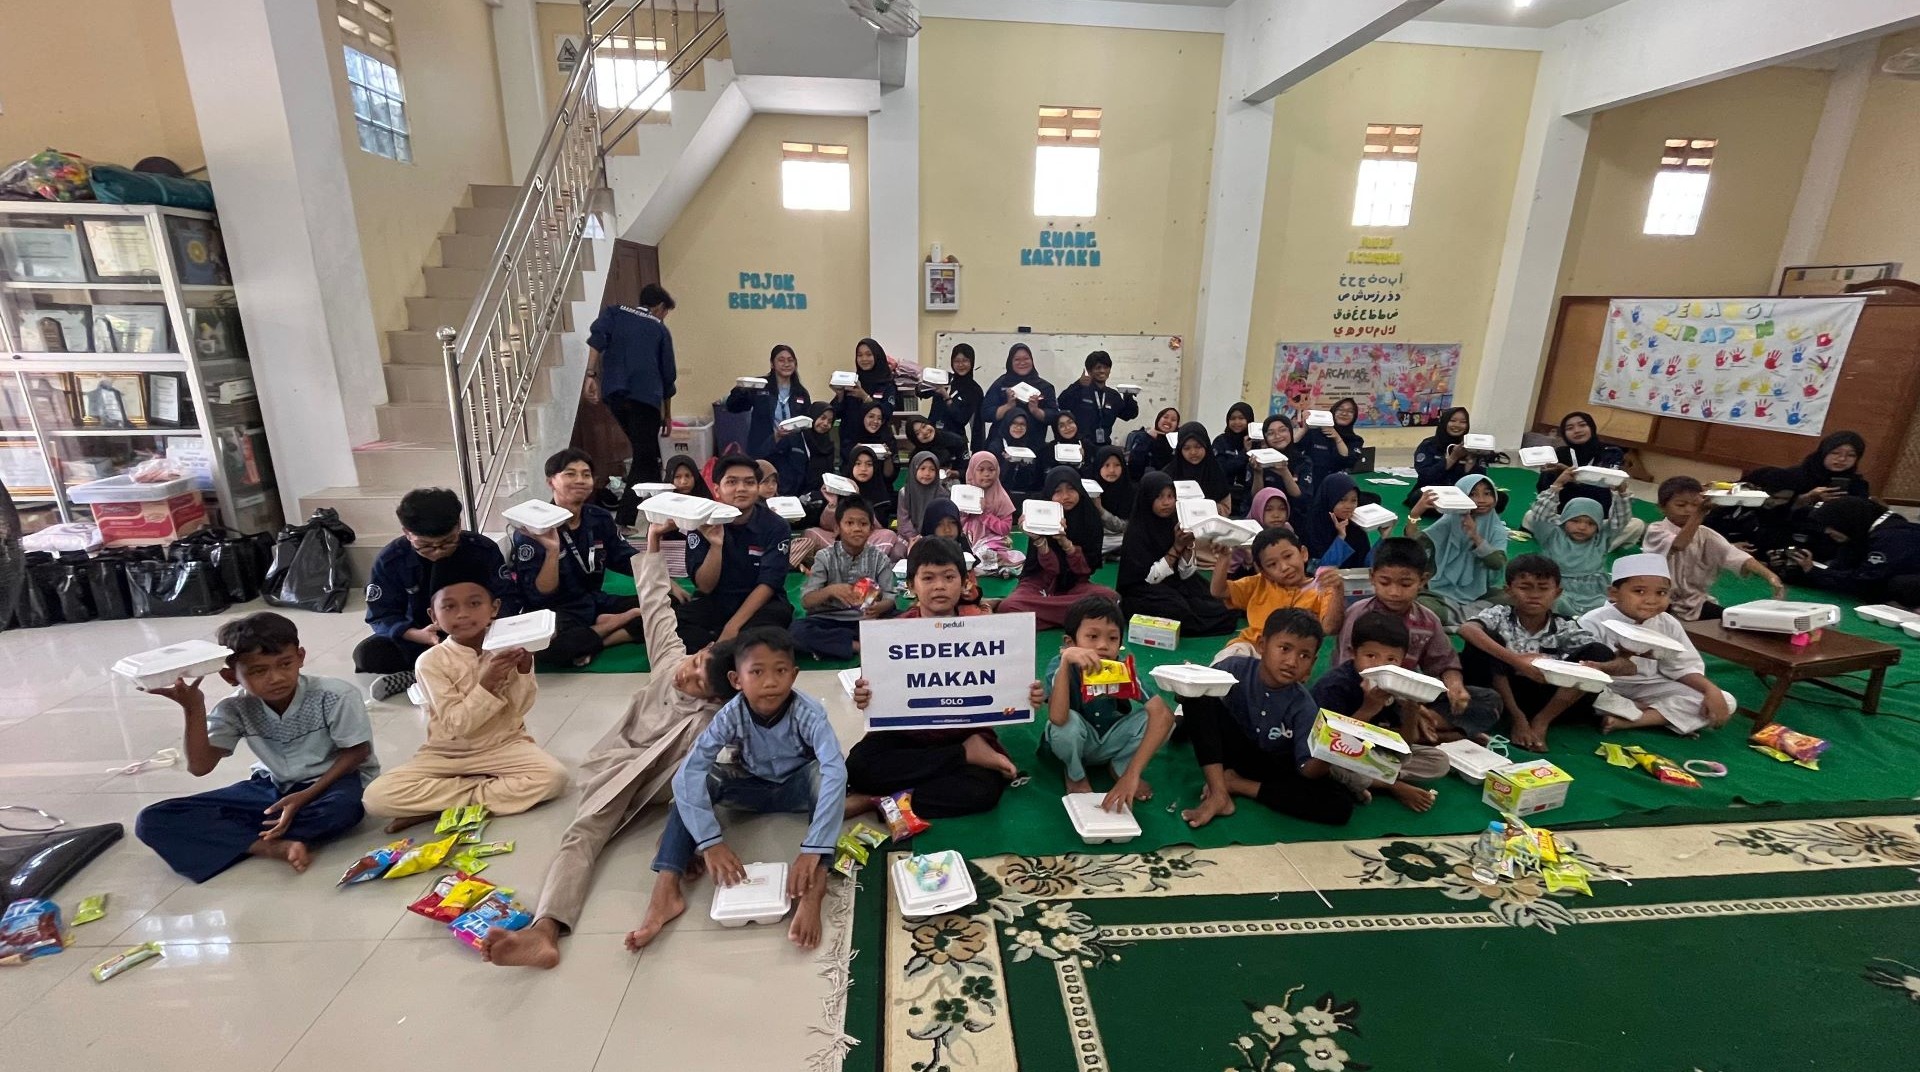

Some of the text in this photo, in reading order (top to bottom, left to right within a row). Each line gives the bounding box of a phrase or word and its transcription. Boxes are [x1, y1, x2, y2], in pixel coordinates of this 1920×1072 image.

[1040, 231, 1096, 249] RUANG
[1021, 248, 1101, 267] KARYAKU
[739, 272, 795, 291] POJOK
[728, 292, 807, 309] BERMAIN
[1662, 301, 1776, 320] PEAGI
[888, 640, 1005, 661] SEDEKAH
[906, 669, 996, 688] MAKAN
[940, 698, 964, 706] SOLO
